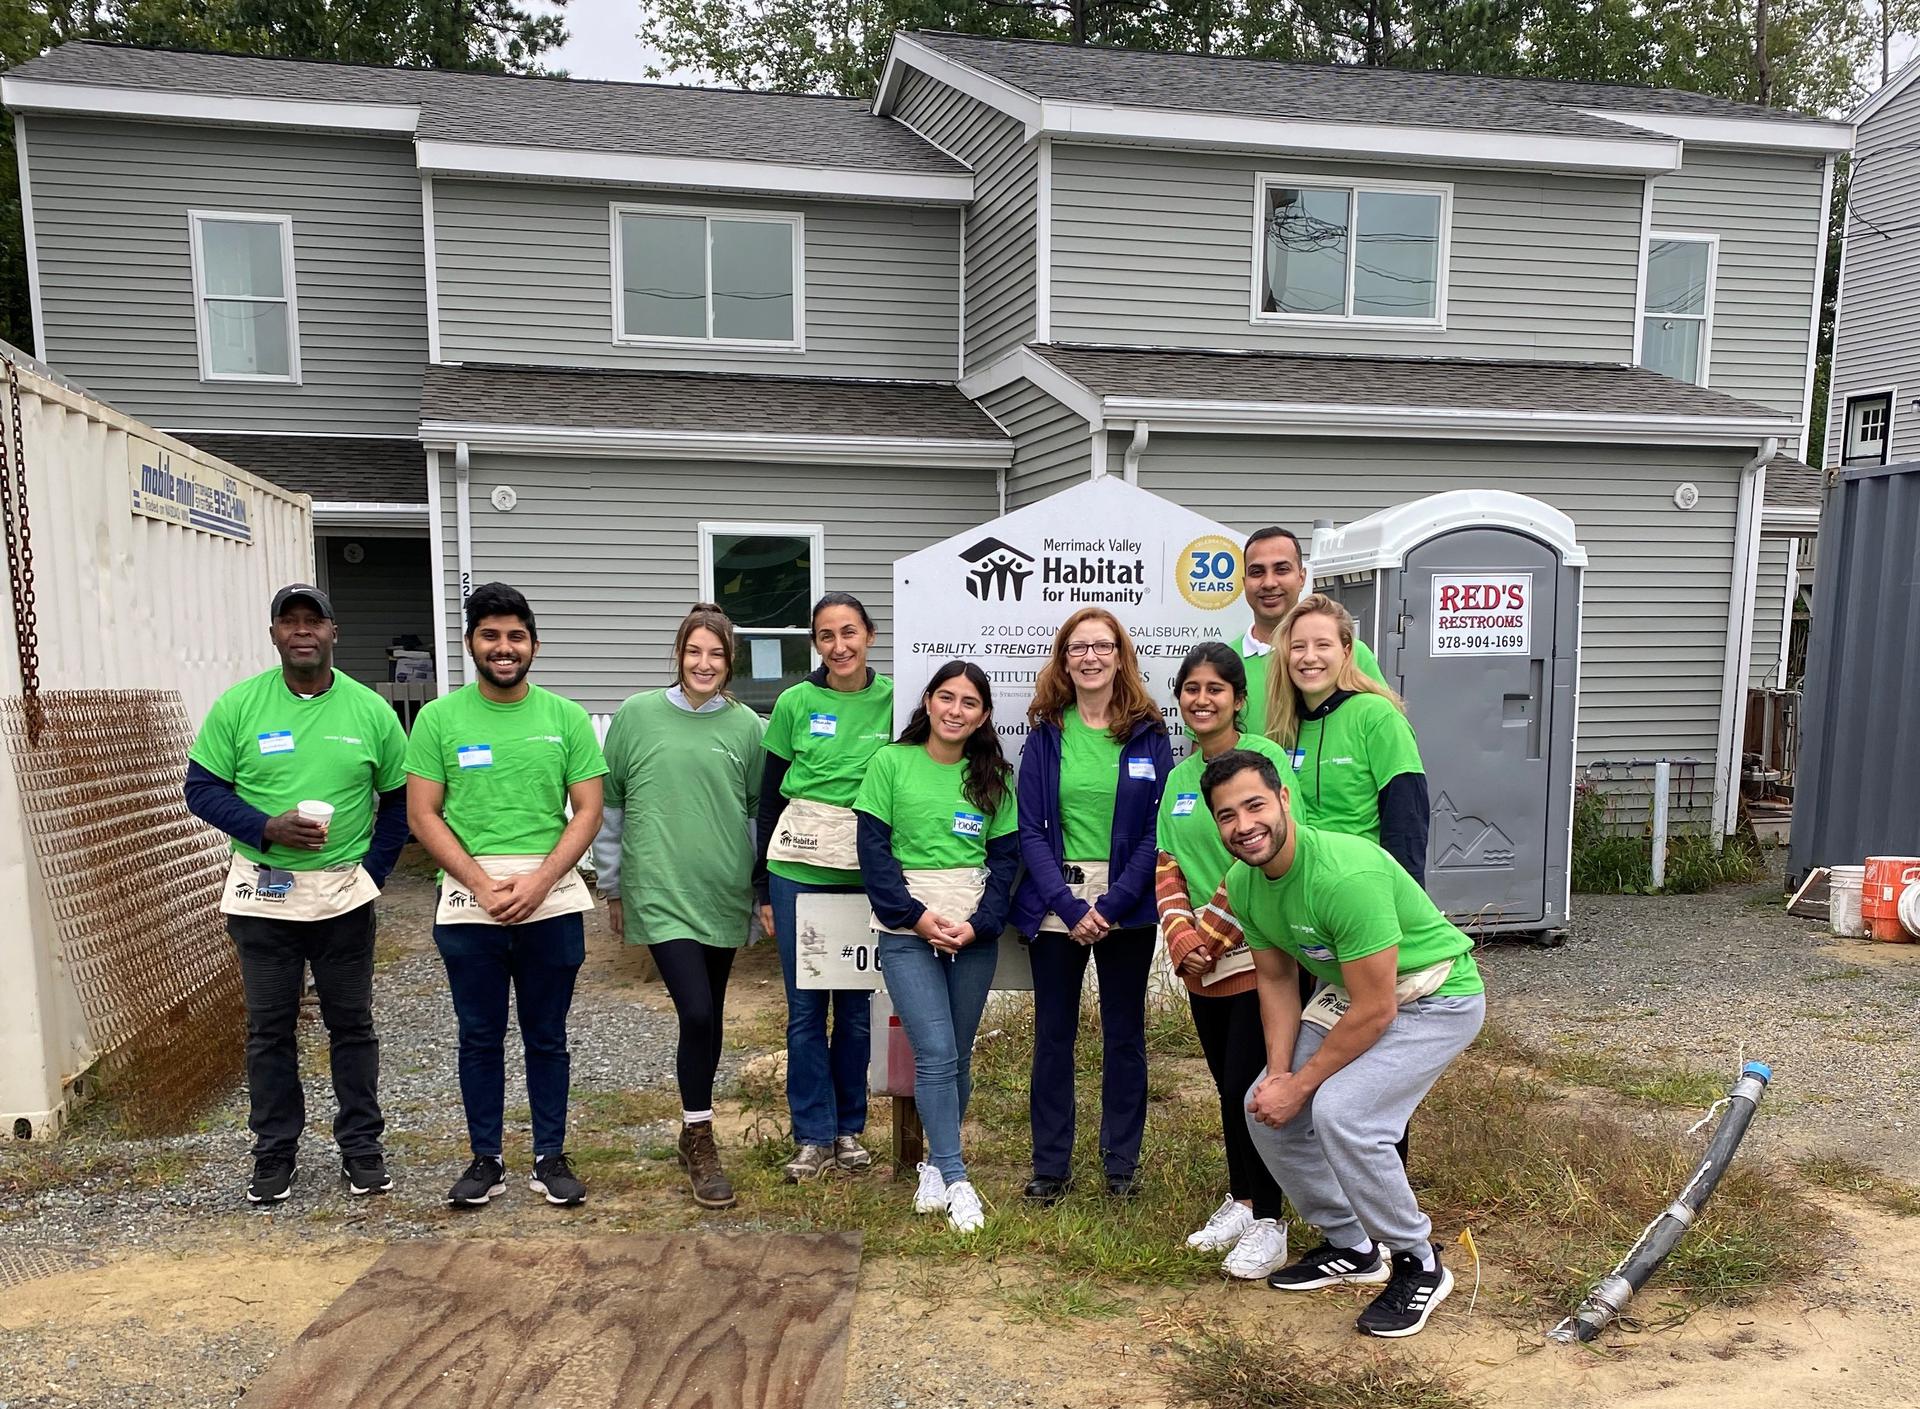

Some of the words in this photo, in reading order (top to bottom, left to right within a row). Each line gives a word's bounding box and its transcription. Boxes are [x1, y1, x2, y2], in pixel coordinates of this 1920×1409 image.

[142, 452, 174, 501] mobile
[176, 472, 194, 508] mini
[1044, 539, 1105, 551] Merrimack
[1109, 539, 1141, 554] Valley
[1043, 557, 1144, 584] Habitat
[1189, 552, 1235, 580] 30
[1189, 582, 1234, 592] YEARS
[1043, 587, 1064, 602] for
[1440, 584, 1524, 613] RED'S
[1439, 616, 1523, 629] RESTROOMS
[981, 626, 995, 636] 22
[998, 626, 1024, 637] OLD
[1027, 626, 1060, 637] COU
[1129, 627, 1200, 639] SALISBURY,
[1203, 627, 1222, 637] MA
[912, 643, 977, 654] STABILITY.
[1438, 635, 1523, 648] 978-904-1699
[793, 837, 817, 846] Habitat
